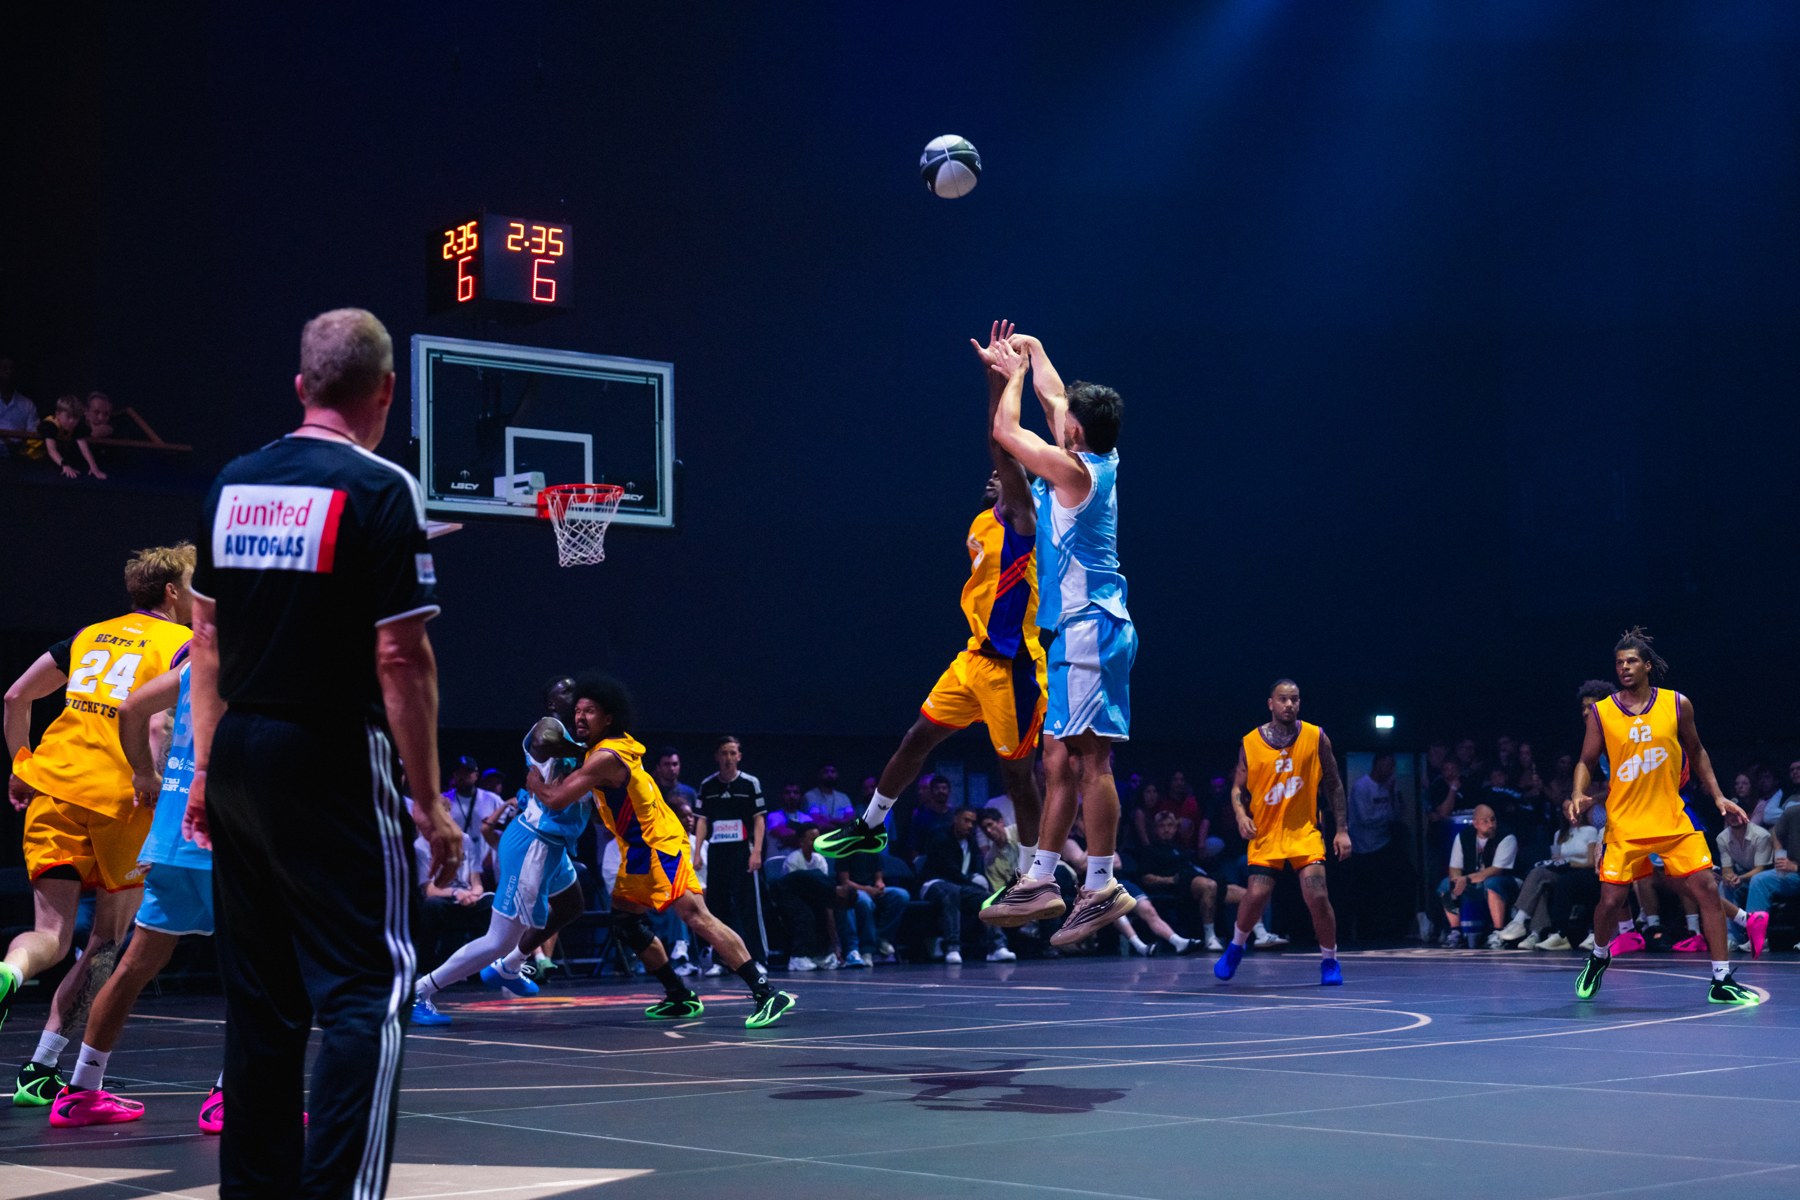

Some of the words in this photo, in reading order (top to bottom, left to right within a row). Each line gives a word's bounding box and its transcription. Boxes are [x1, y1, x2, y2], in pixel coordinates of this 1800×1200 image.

[458, 256, 472, 301] 6
[533, 258, 556, 302] 6
[226, 495, 313, 531] junited
[94, 633, 134, 647] BEATS
[66, 649, 143, 701] 24
[1628, 725, 1653, 743] 42
[1275, 758, 1293, 773] 23
